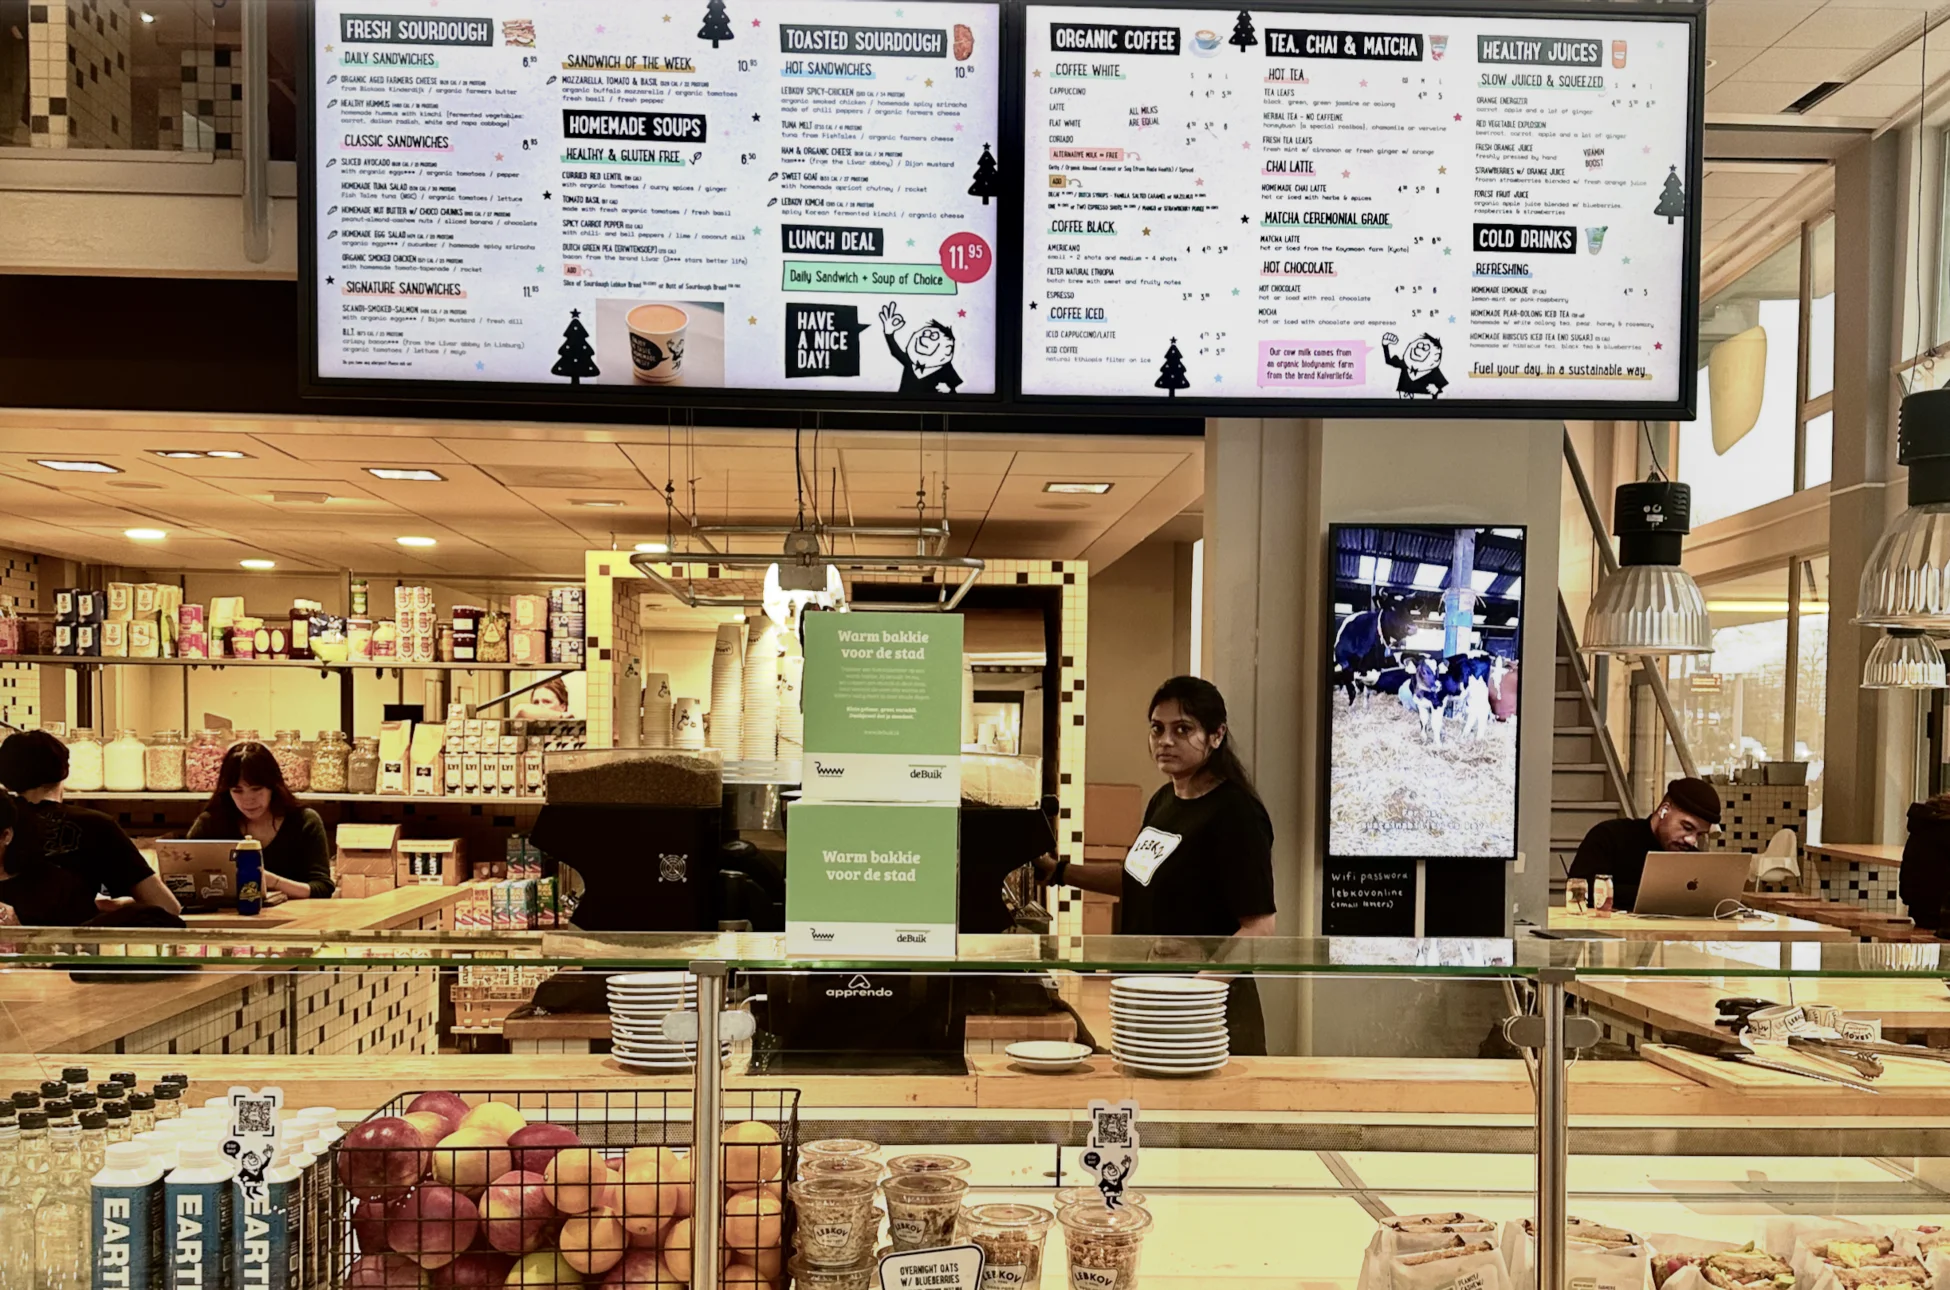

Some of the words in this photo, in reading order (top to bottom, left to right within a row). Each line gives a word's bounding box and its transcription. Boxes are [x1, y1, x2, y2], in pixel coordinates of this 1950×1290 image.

[346, 20, 392, 39] FRESH
[398, 21, 488, 42] SOURDOUGH
[787, 29, 848, 50] TOASTED
[856, 32, 941, 52] SOURDOUGH
[1056, 29, 1118, 49] ORGANIC
[1125, 31, 1176, 50] COFFEE
[1306, 35, 1338, 54] CHAI
[1344, 36, 1357, 55] &
[1364, 37, 1418, 56] MATCHA
[1483, 41, 1542, 60] HEALTHY
[1548, 43, 1598, 62] JUICES
[345, 52, 369, 64] DAILY
[373, 53, 435, 66] SANDWICHES
[568, 55, 621, 69] SANDWICH
[626, 56, 638, 69] OF
[642, 57, 660, 70] THE
[665, 57, 692, 70] WEEK
[785, 62, 804, 75] HOT
[808, 62, 872, 76] SANDWICHES
[1056, 63, 1088, 76] COFFEE
[1092, 64, 1120, 77] WHITE
[1269, 68, 1285, 80] HOT
[1290, 69, 1304, 81] TEA
[1482, 74, 1507, 86] SLOW
[1512, 75, 1542, 86] JUICED
[1547, 74, 1554, 87] &
[1559, 76, 1604, 88] SQUEEZED
[1050, 88, 1086, 96] CAPPUCCINO
[1265, 88, 1275, 96] TEA
[1277, 89, 1295, 97] LEAFS
[1050, 103, 1065, 111] LATTE
[1129, 106, 1139, 116] ALL
[1141, 106, 1158, 115] MILKS
[570, 116, 647, 135] HOMEMADE
[654, 118, 701, 137] SOUPS
[782, 121, 797, 129] TUNA
[799, 122, 812, 130] MELT
[1050, 119, 1061, 127] FLAT
[1064, 120, 1081, 128] WHITE
[1129, 118, 1139, 127] ARE
[1142, 117, 1160, 126] EQUAL
[345, 135, 383, 147] CLASSIC
[388, 136, 449, 149] SANDWICHES
[1494, 144, 1515, 152] ORANGE
[1518, 144, 1533, 152] JUICE
[566, 148, 604, 161] HEALTHY
[608, 150, 617, 161] &
[621, 150, 655, 162] GLUTEN
[659, 151, 680, 163] FREE
[1583, 149, 1605, 157] VITAMIN
[341, 158, 362, 166] SLICED
[1266, 160, 1287, 172] CHAI
[1290, 161, 1314, 173] LATTE
[1585, 160, 1604, 168] BOOST
[1265, 212, 1300, 224] MATCHA
[1304, 212, 1358, 225] CEREMONIAL
[1362, 213, 1390, 226] GRADE
[1052, 220, 1084, 232] COFFEE
[1087, 221, 1115, 233] BLACK
[789, 230, 835, 250] LUNCH
[842, 233, 876, 251] DEAL
[1480, 229, 1514, 248] COLD
[1521, 230, 1572, 249] DRINKS
[1048, 244, 1080, 252] AMERICANO
[949, 245, 983, 270] 11.95
[1264, 261, 1281, 273] HOT
[1284, 262, 1334, 274] CHOCOLATE
[1476, 263, 1529, 275] REFRESHING
[790, 270, 812, 284] Daily
[816, 271, 858, 283] Sandwich
[872, 272, 895, 287] Soup
[900, 273, 909, 285] of
[914, 273, 943, 286] Choice
[346, 281, 396, 294] SIGNATURE
[399, 283, 461, 296] SANDWICHES
[1047, 291, 1074, 299] ESPRESSO
[1051, 307, 1082, 319] COFFEE
[1085, 308, 1105, 320] ICED
[798, 312, 835, 330] HAVE
[798, 332, 808, 350] A
[815, 332, 848, 350] NICE
[1270, 348, 1282, 356] Our
[1298, 348, 1311, 356] milk
[1336, 348, 1352, 356] from
[798, 351, 830, 369] DAY!
[1277, 360, 1299, 370] organic
[1302, 360, 1336, 370] biodynamic
[1338, 360, 1354, 368] farm
[1298, 372, 1315, 380] brand
[1474, 362, 1494, 374] Fuel
[1497, 364, 1520, 376] your
[1547, 364, 1555, 375] in
[1559, 367, 1564, 375] a
[1569, 364, 1622, 376] sustainable
[1627, 366, 1648, 378] way.
[838, 630, 880, 643] Warm
[883, 631, 929, 643] bakkie
[841, 648, 874, 659] voor
[876, 648, 892, 660] de
[895, 648, 925, 660] stad
[910, 769, 942, 779] deBuik
[822, 850, 867, 864] Warm
[871, 851, 921, 864] bakkie
[826, 869, 861, 881] voor
[864, 869, 881, 881] de
[884, 869, 916, 882] stad
[897, 935, 927, 943] deBuik
[826, 988, 893, 998] apprendo
[817, 1226, 848, 1237] LEBKOV
[895, 1222, 922, 1234] LEBKOV
[103, 1198, 130, 1290] EART
[177, 1195, 203, 1290] EART
[244, 1200, 270, 1290] EART
[900, 1264, 937, 1276] OVERNIGHT
[940, 1263, 959, 1273] OATS
[901, 1278, 912, 1287] W/
[916, 1275, 960, 1286] BLUEBERRIES
[1075, 1272, 1113, 1286] LEBKOV
